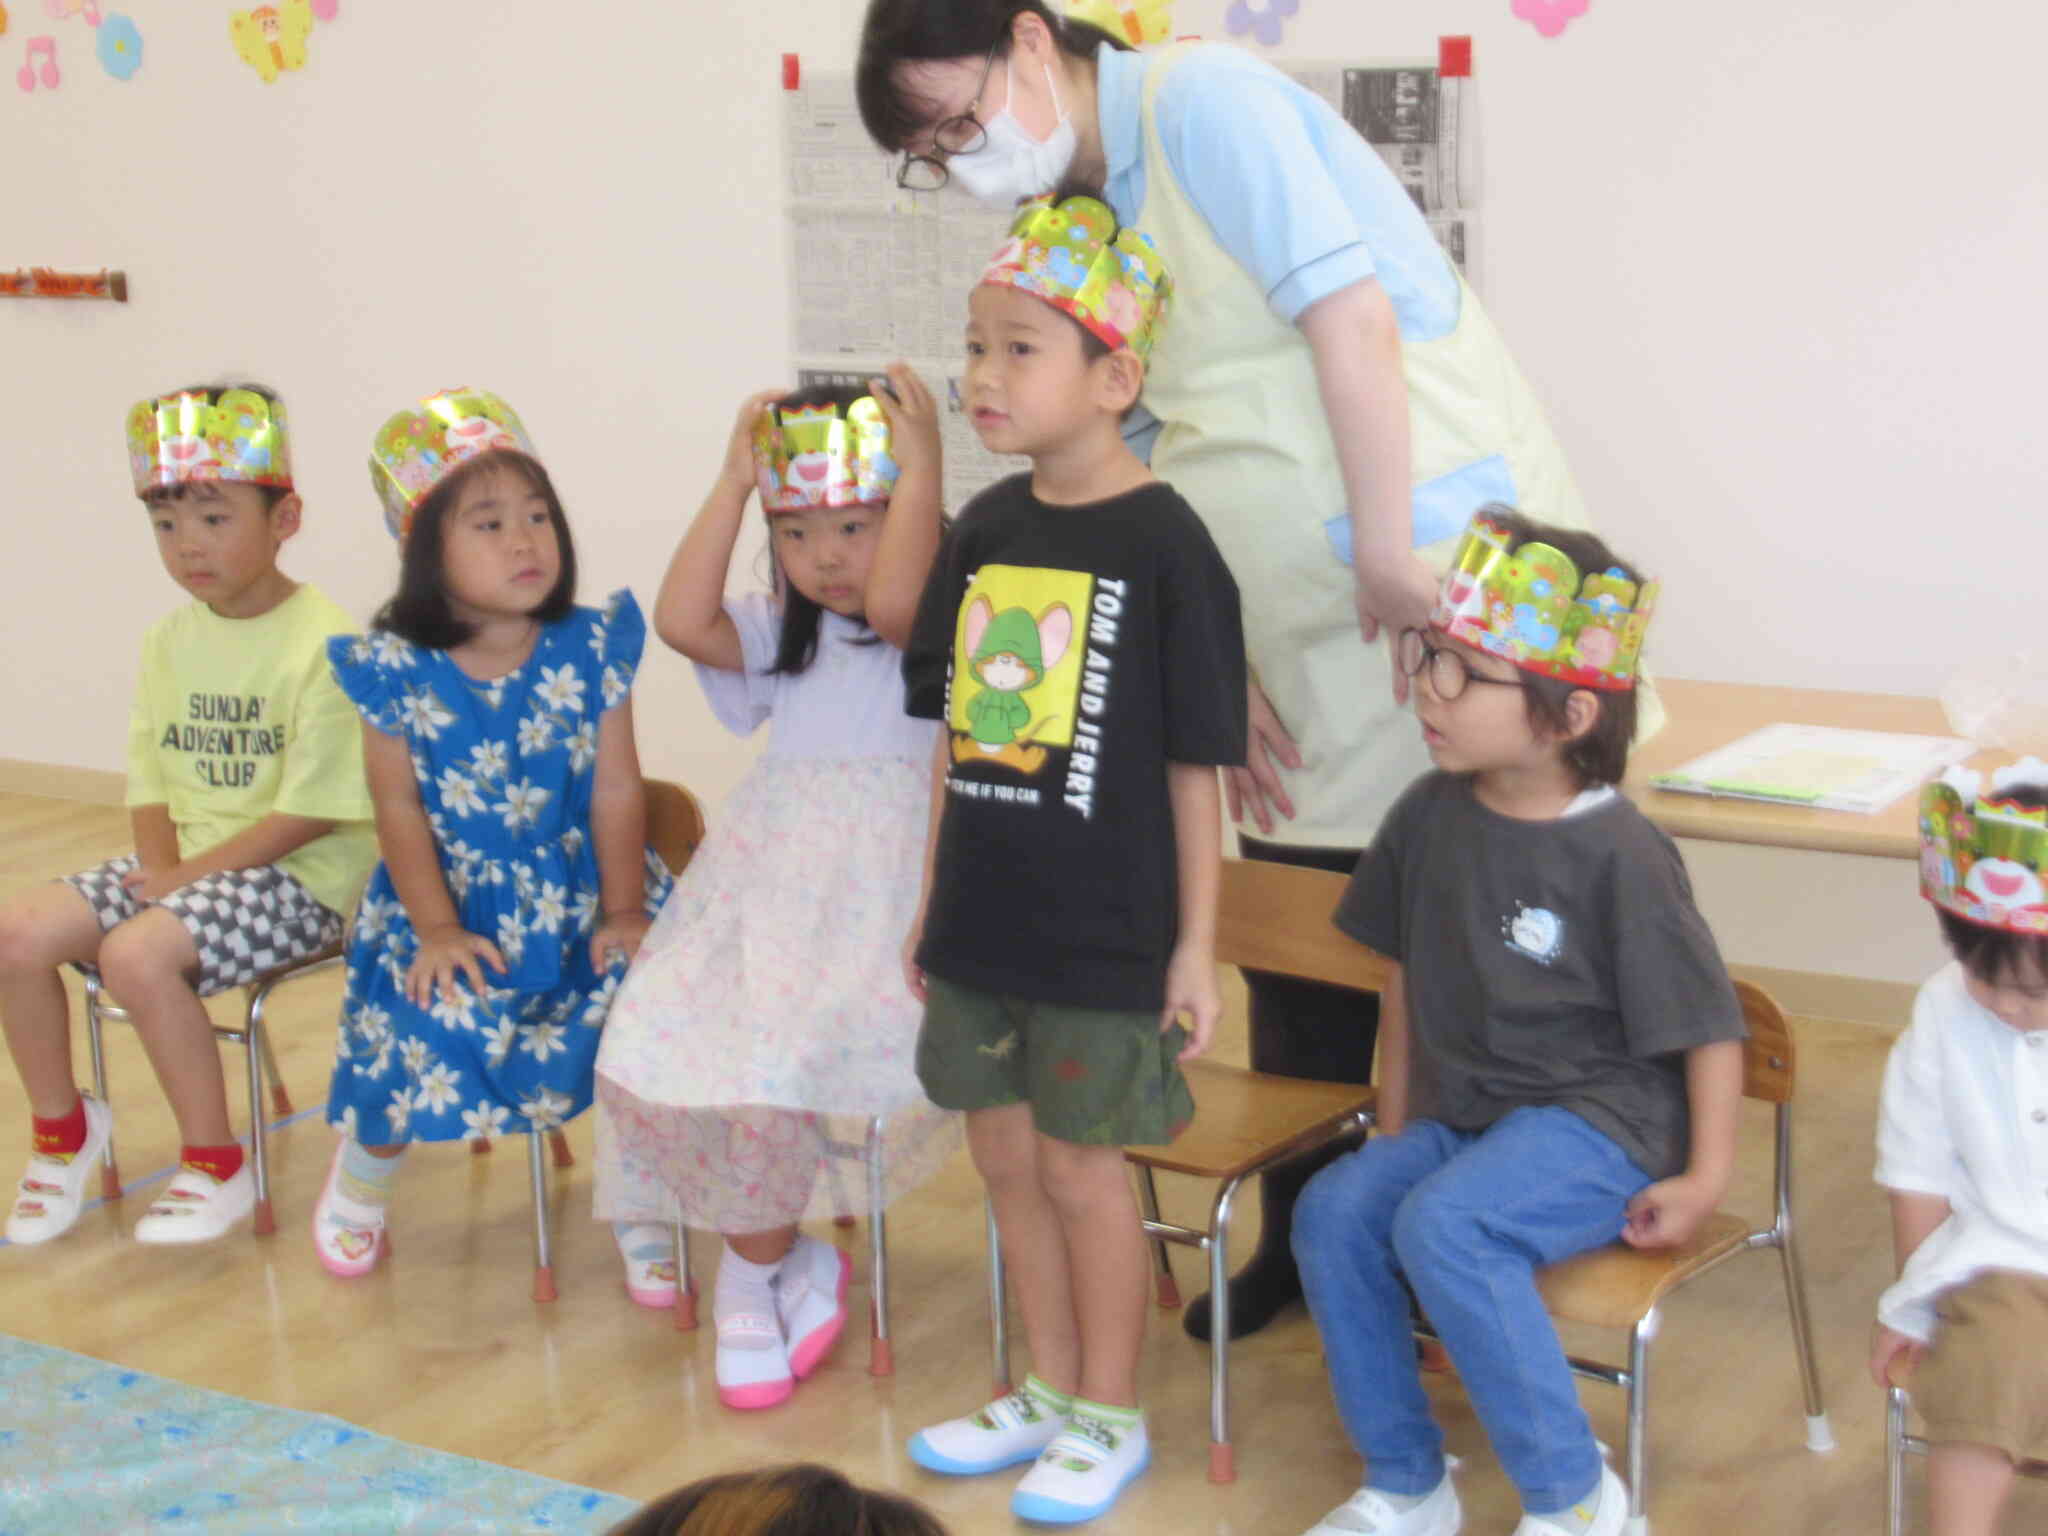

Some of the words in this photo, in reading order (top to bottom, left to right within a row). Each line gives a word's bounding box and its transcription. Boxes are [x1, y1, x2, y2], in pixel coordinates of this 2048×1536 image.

[1090, 577, 1124, 645] TOM
[1079, 647, 1112, 716] AND
[160, 723, 286, 755] ADVENTURE
[195, 759, 257, 787] CLUB
[980, 783, 993, 798] IF
[994, 784, 1015, 801] YOU
[1016, 787, 1041, 804] CAN
[1063, 717, 1101, 821] JERRY
